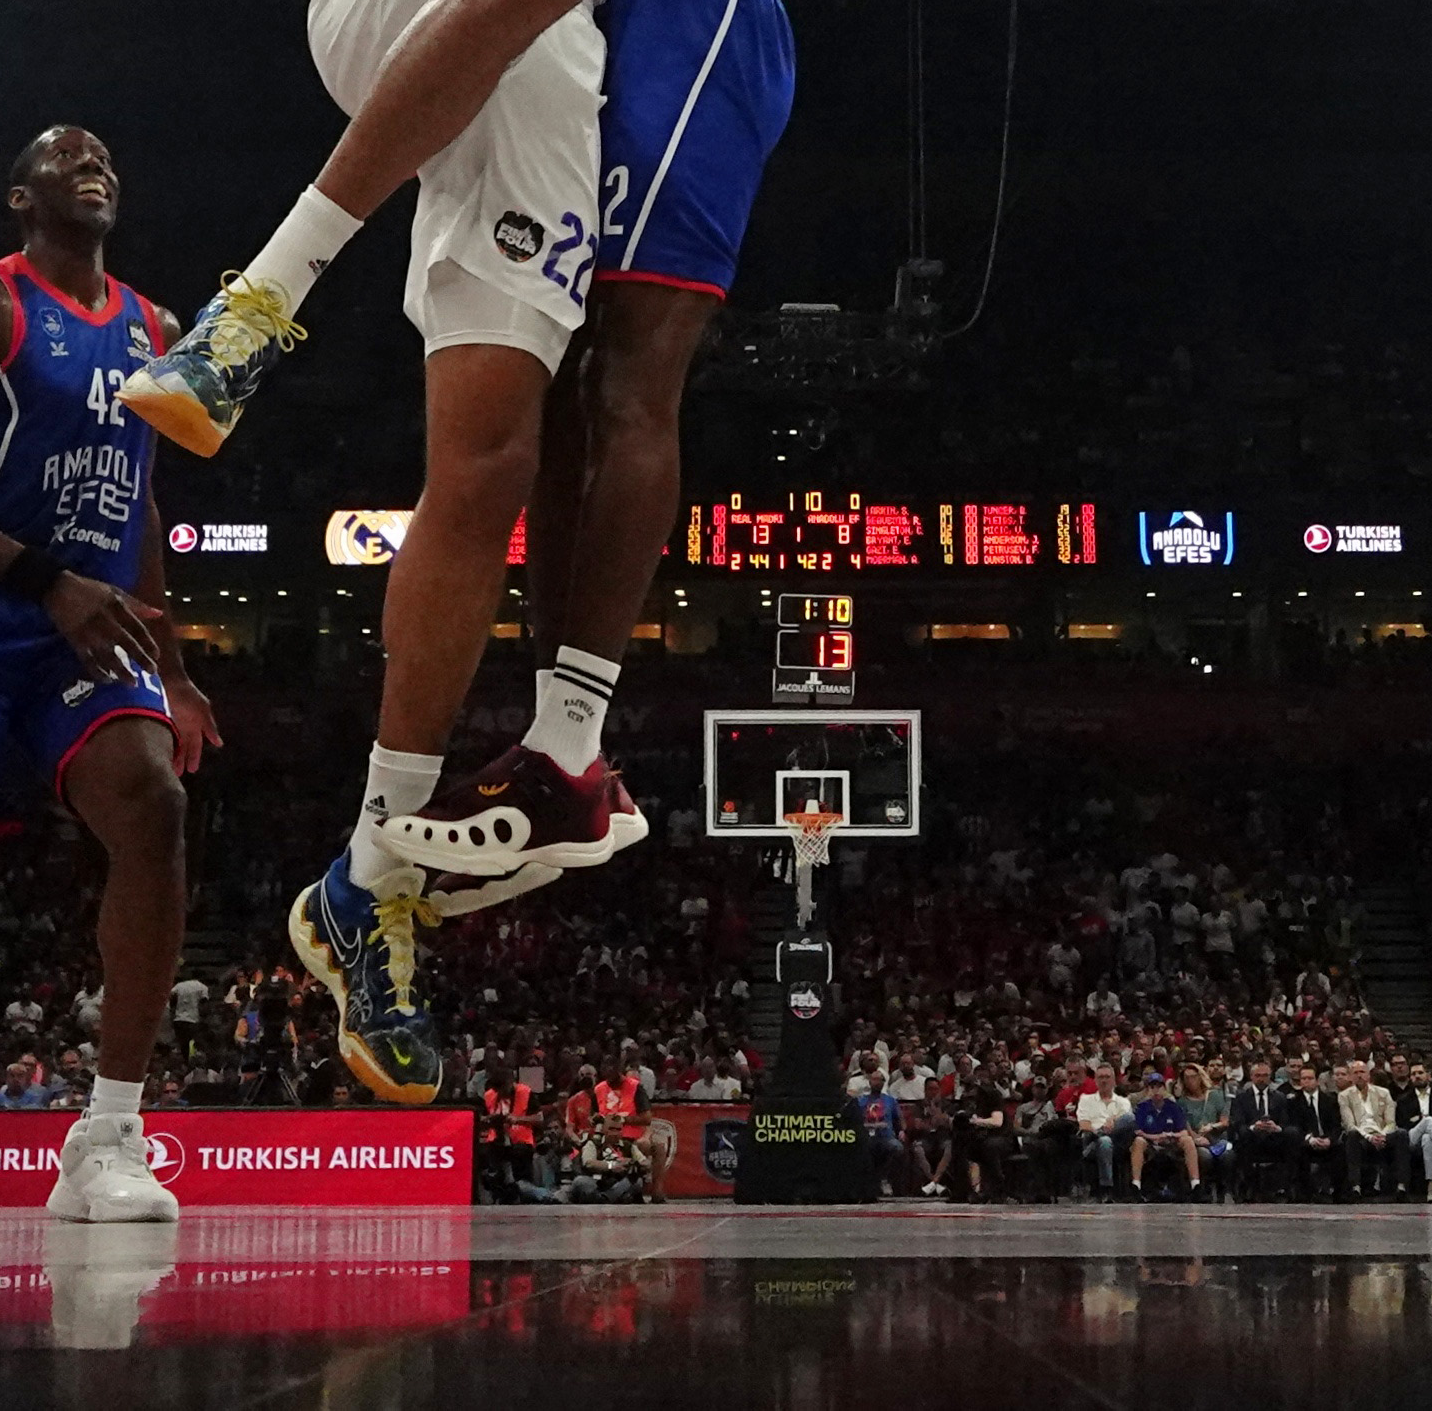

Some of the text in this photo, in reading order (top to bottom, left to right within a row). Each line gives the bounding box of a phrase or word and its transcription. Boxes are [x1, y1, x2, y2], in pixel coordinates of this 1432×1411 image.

[87, 367, 125, 428] 42
[731, 493, 742, 510] 0
[850, 493, 860, 510] 0
[731, 514, 752, 524] REAL
[808, 514, 860, 524] ANADOLU EF
[202, 525, 267, 538] TURKISH
[753, 525, 769, 544] 13
[838, 525, 850, 544] 8
[1336, 526, 1401, 539] TURKISH
[201, 538, 267, 551] AIRLINES
[1153, 528, 1221, 551] ANADOLU
[1336, 539, 1402, 552] AIRLINES
[731, 553, 741, 570] 2
[749, 554, 769, 569] 44
[797, 554, 817, 569] 42
[822, 553, 832, 570] 2
[851, 554, 861, 569] 4
[1164, 547, 1212, 563] EFES
[805, 599, 850, 622] 1:10
[819, 636, 849, 668] 13
[777, 683, 851, 695] JACQUES LEMANS
[755, 1115, 834, 1129] ULTIMATE
[755, 1129, 857, 1143] CHAMPIONS
[198, 1145, 455, 1170] TURKISH AIRLINES
